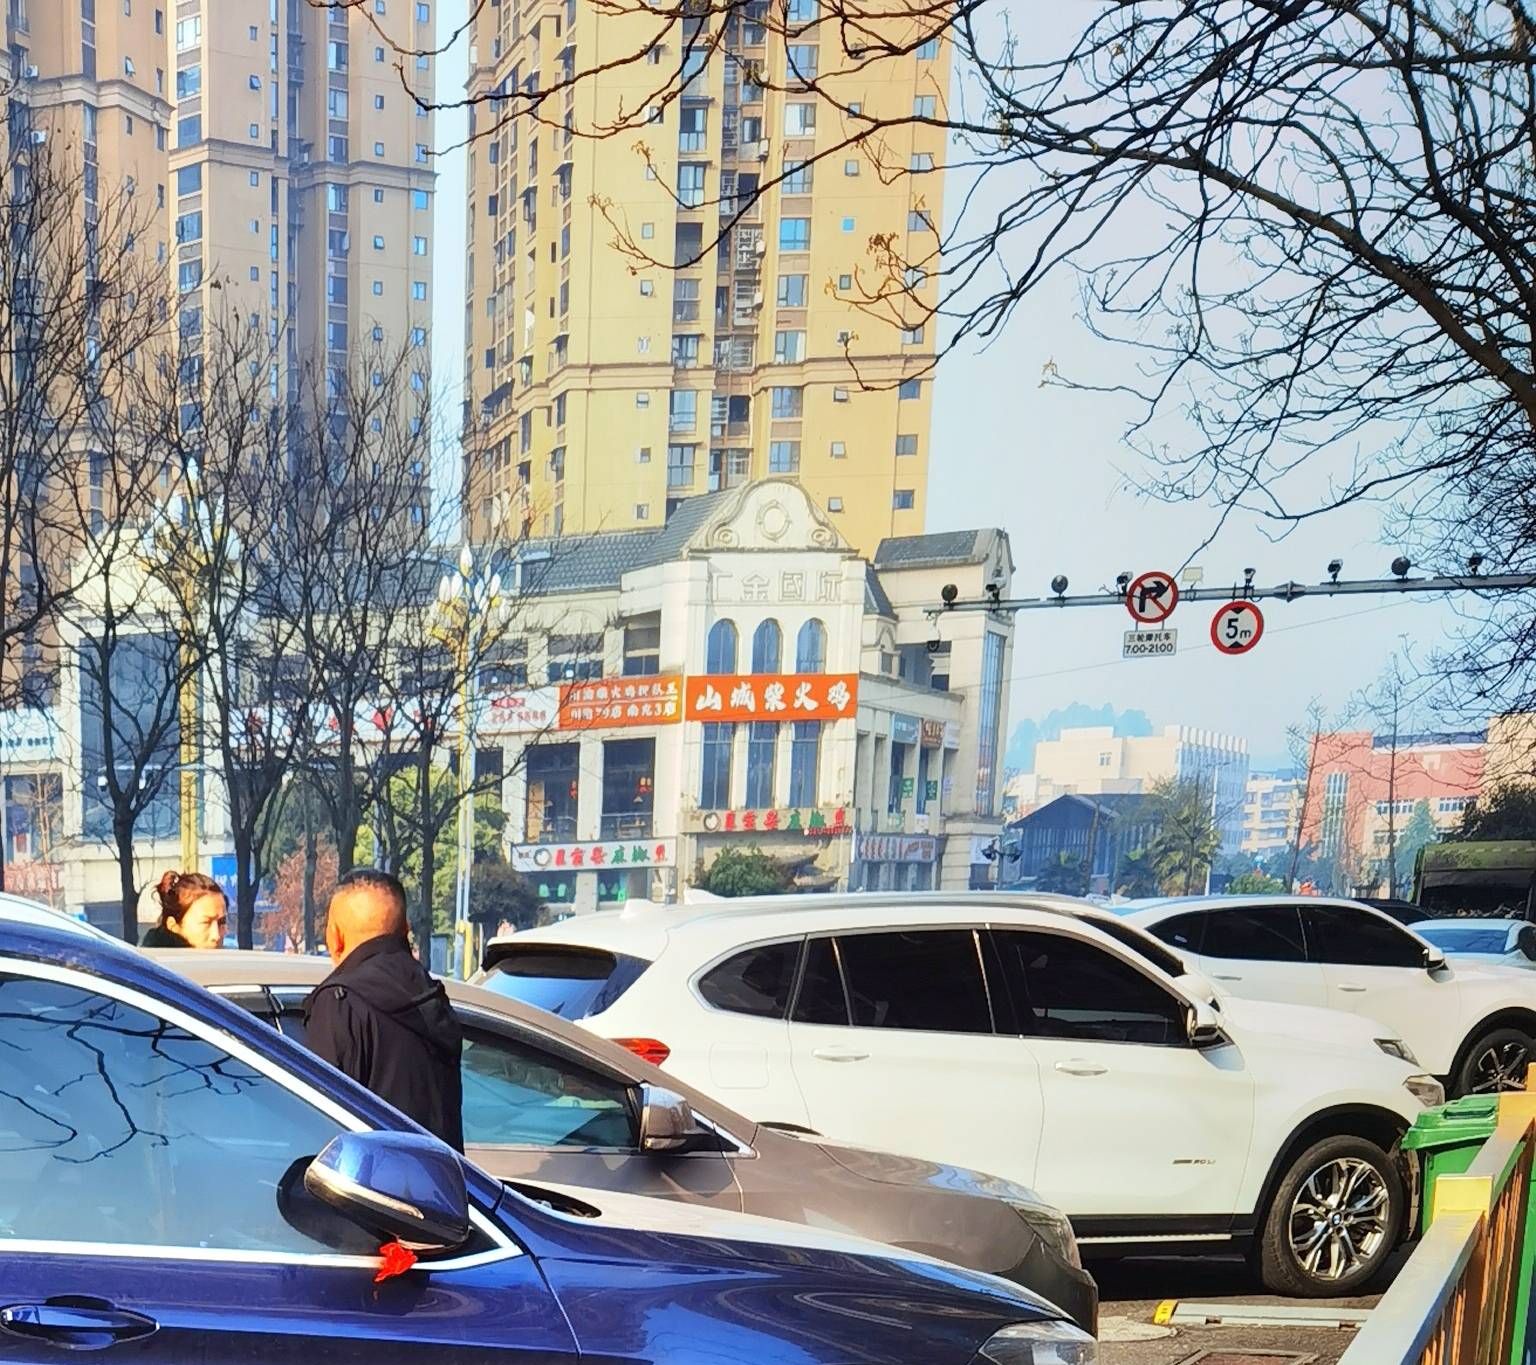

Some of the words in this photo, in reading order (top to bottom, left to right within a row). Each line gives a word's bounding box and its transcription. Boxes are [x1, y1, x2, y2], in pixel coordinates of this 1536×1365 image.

[1127, 632, 1172, 643] 三轮摩托车
[695, 680, 851, 712] 山城柴火鸡
